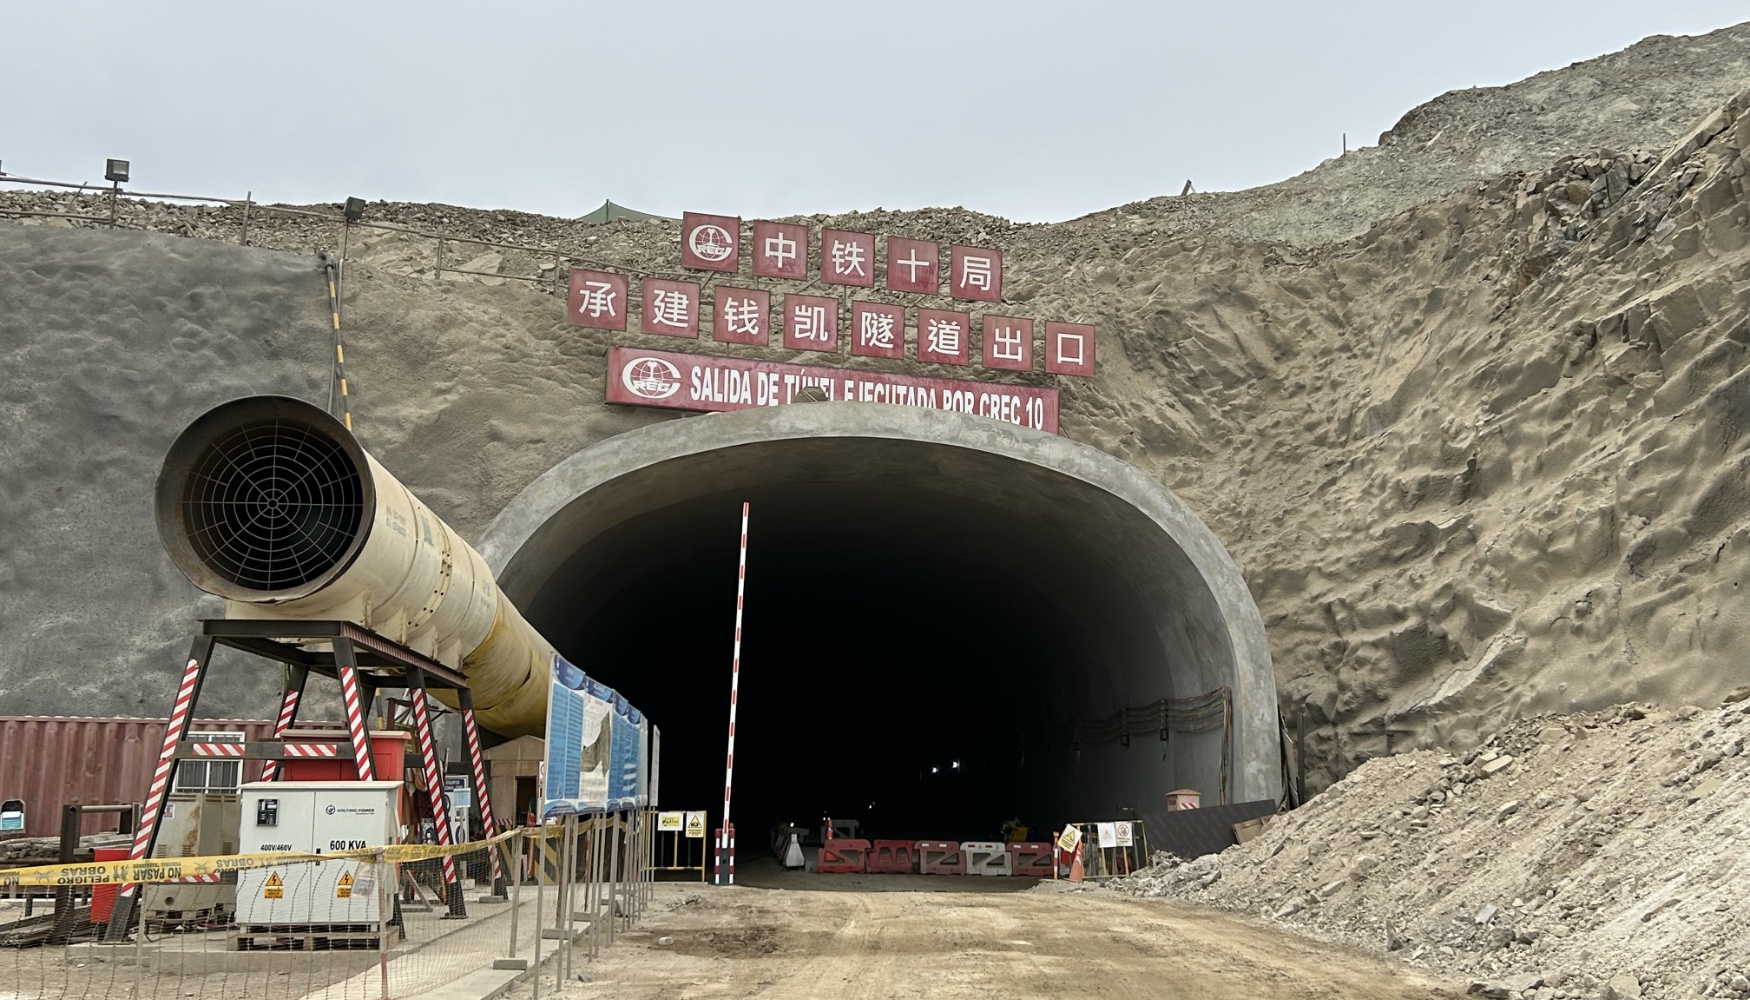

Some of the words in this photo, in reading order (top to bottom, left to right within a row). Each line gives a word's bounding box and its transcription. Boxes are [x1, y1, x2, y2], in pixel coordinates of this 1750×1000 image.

[765, 232, 992, 291] 中铁十局
[579, 281, 1084, 366] 承建钱凯隧道出口
[690, 365, 752, 405] SALIDA
[757, 371, 780, 407] DE
[784, 368, 835, 404] TÚEL
[943, 388, 975, 415] POR
[979, 392, 1021, 426] CREC
[1025, 397, 1044, 431] 10
[330, 840, 346, 850] 600
[348, 840, 367, 850] KVA
[216, 858, 254, 868] OBRAS
[61, 865, 106, 876] OBRAS
[133, 867, 166, 881] PASAR
[168, 867, 182, 879] NO
[58, 875, 110, 884] PELIGRO
